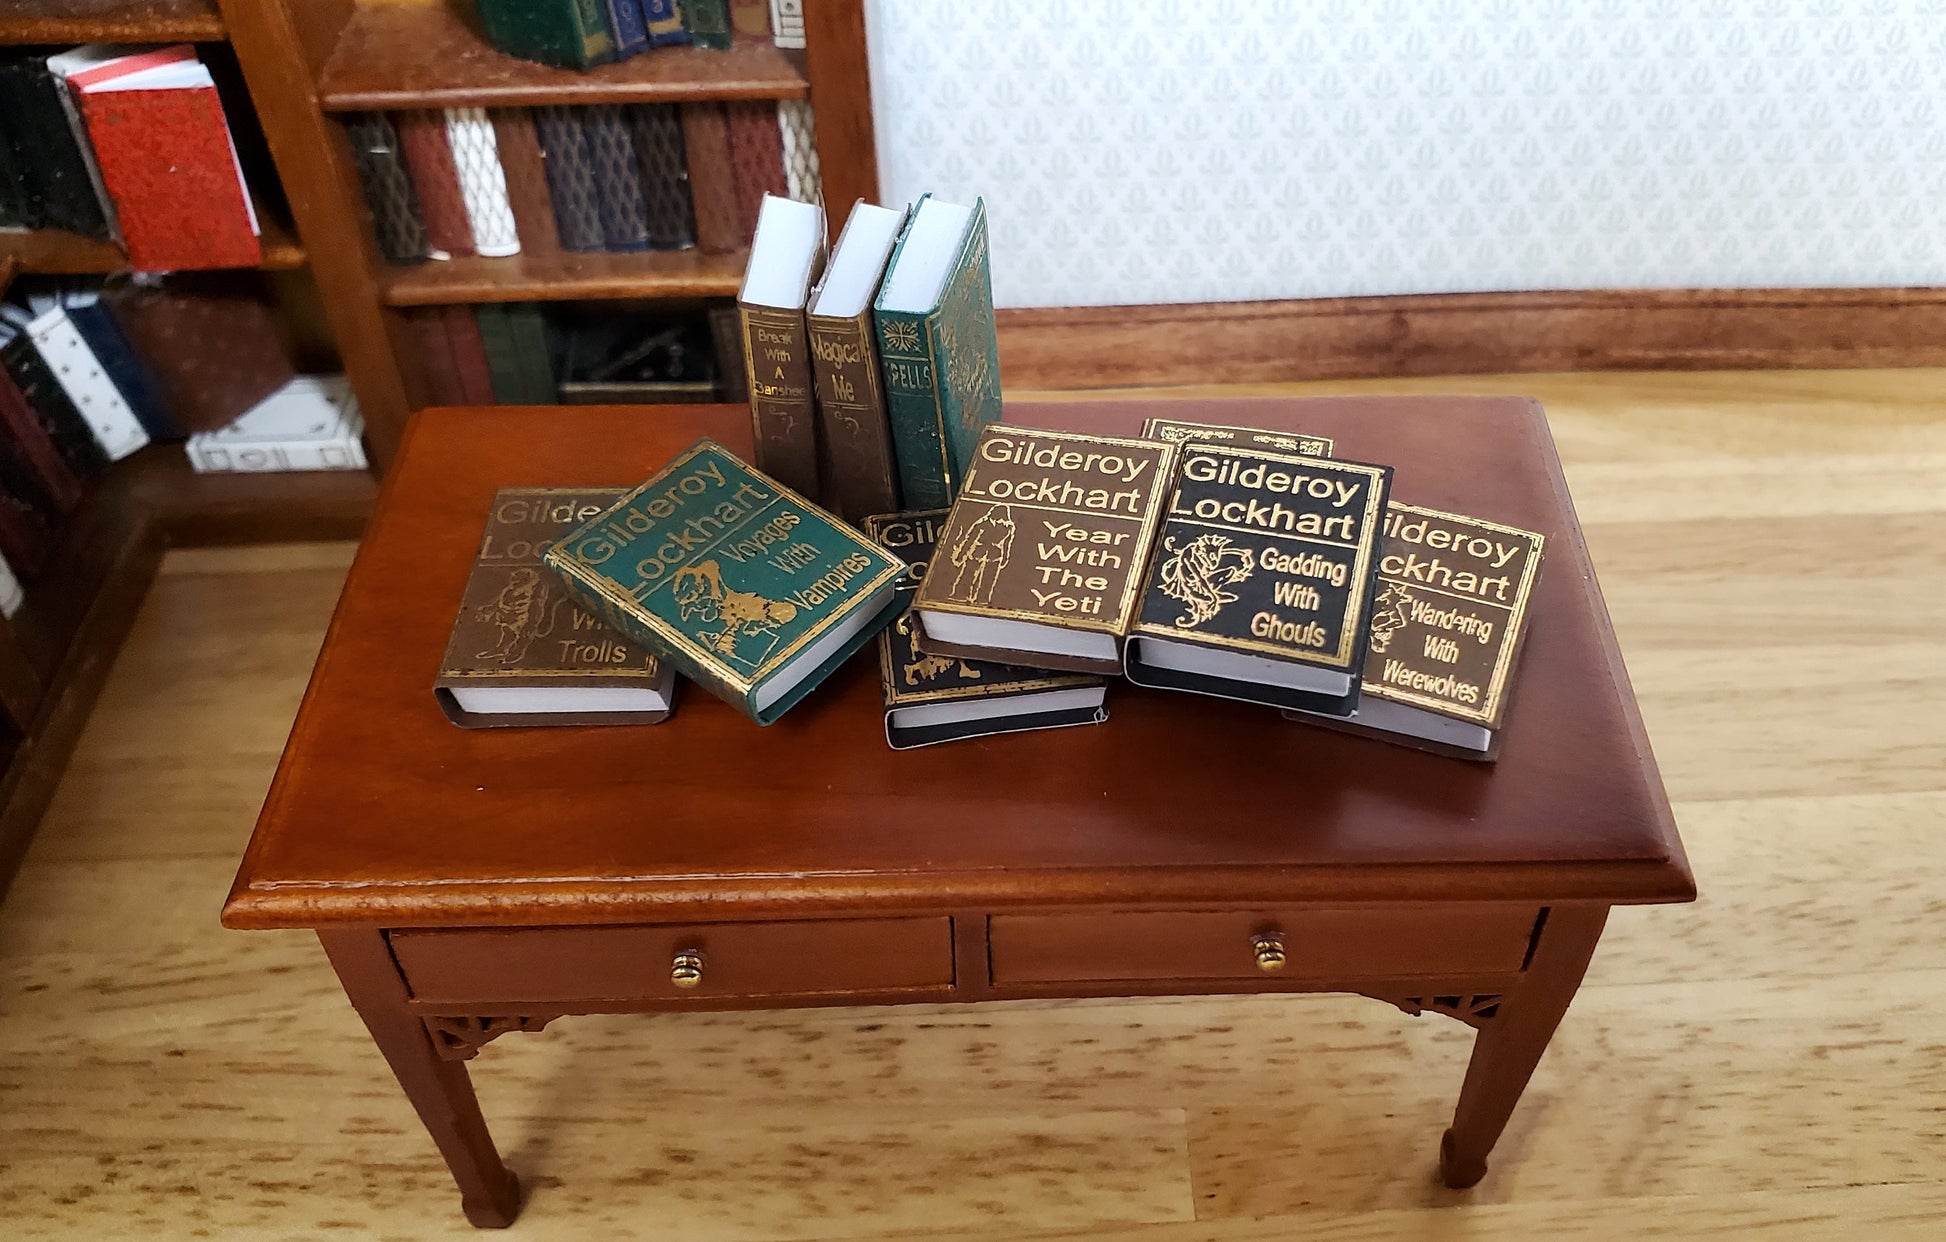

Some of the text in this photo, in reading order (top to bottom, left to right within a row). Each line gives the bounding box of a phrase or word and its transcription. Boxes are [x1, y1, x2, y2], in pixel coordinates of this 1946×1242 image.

[758, 328, 793, 344] Break
[765, 348, 792, 362] With
[774, 366, 785, 380] A
[831, 374, 856, 402] Me
[981, 438, 1149, 483] Gilderoy
[964, 468, 1142, 513] Lockhart
[1183, 456, 1361, 508] Gilderoy
[497, 500, 602, 524] Gilde
[576, 460, 727, 566] Gilderoy
[1170, 489, 1355, 540] Lockhart
[605, 482, 769, 603] Lockhart
[719, 510, 801, 563] Voyages
[1042, 520, 1131, 546] Year
[1383, 513, 1520, 569] ilderoy
[767, 540, 822, 576] With
[1037, 543, 1122, 570] With
[1259, 547, 1348, 588] Gadding
[785, 551, 873, 612] Vampires
[1035, 566, 1109, 591] The
[1380, 553, 1511, 601] ckhart
[1030, 588, 1103, 615] Yeti
[1274, 581, 1321, 612] With
[1250, 611, 1327, 647] Ghouls
[1410, 600, 1494, 645] Wandering
[558, 640, 628, 664] Trolls
[1423, 634, 1460, 664] With
[1382, 658, 1480, 704] Werewolves
